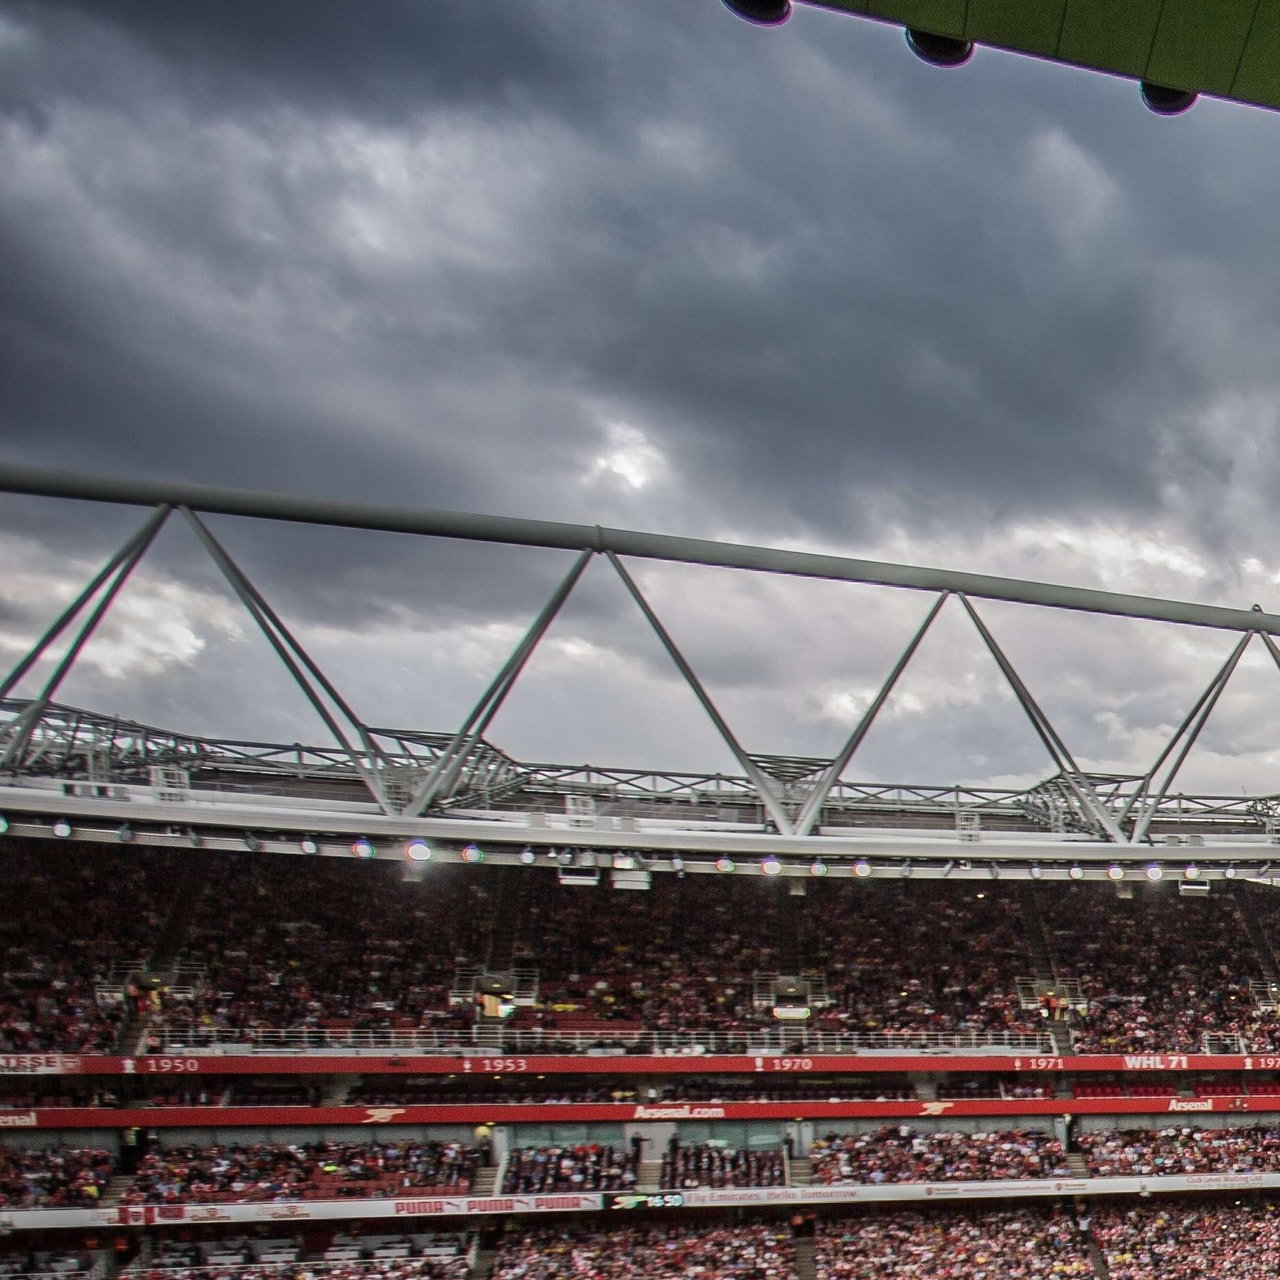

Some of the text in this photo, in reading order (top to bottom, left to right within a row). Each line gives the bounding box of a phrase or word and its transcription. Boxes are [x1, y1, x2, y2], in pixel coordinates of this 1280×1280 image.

[147, 1059, 199, 1072] 1950
[482, 1060, 528, 1071] 1953
[772, 1059, 813, 1071] 1970
[1029, 1058, 1064, 1069] 1971
[1124, 1056, 1189, 1069] WHL 71
[1168, 1099, 1213, 1111] Arsenal
